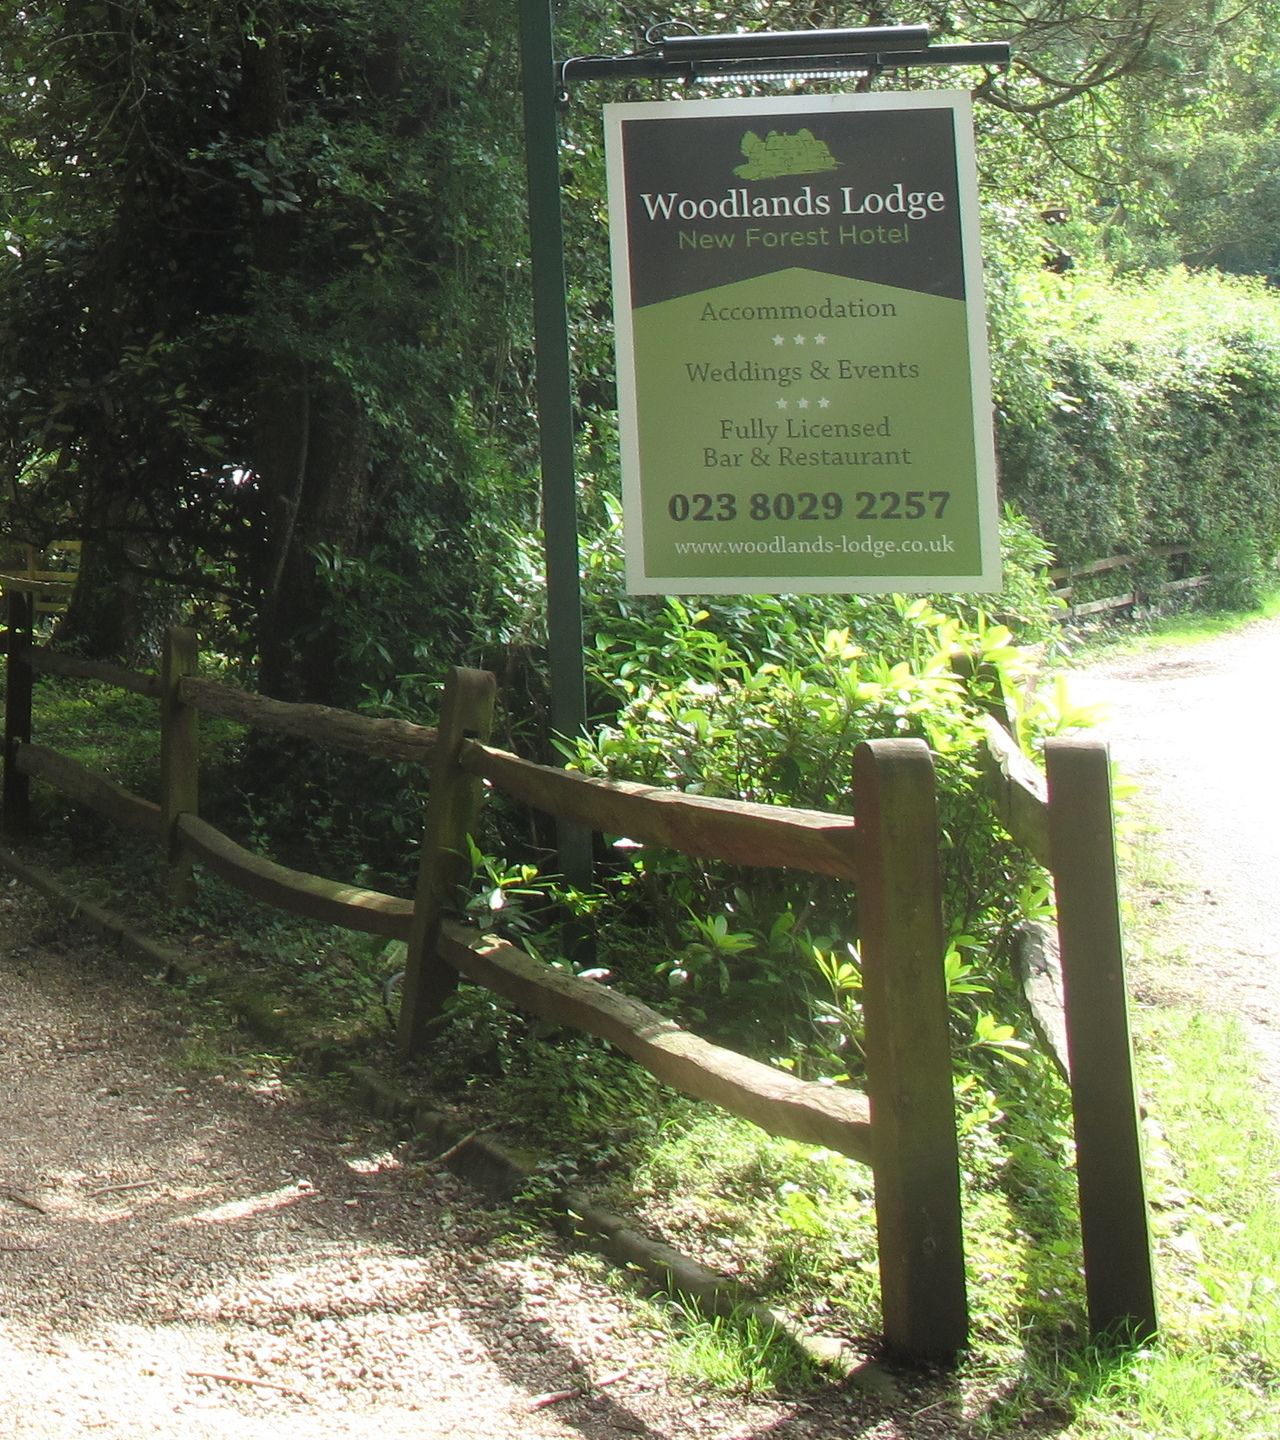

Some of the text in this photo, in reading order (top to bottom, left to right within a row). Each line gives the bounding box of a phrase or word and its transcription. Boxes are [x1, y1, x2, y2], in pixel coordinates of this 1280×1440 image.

[640, 184, 945, 220] Woodlands Lodge
[679, 223, 909, 250] New Forest Hotel
[700, 298, 897, 321] Accommodation
[686, 360, 920, 387] Weddings & Events
[720, 416, 891, 444] Fully Licensed
[703, 446, 912, 467] Bar & Restaurant
[668, 491, 951, 522] 023 8029 2257
[674, 535, 955, 558] www.woodlands-lodge.co.uk
